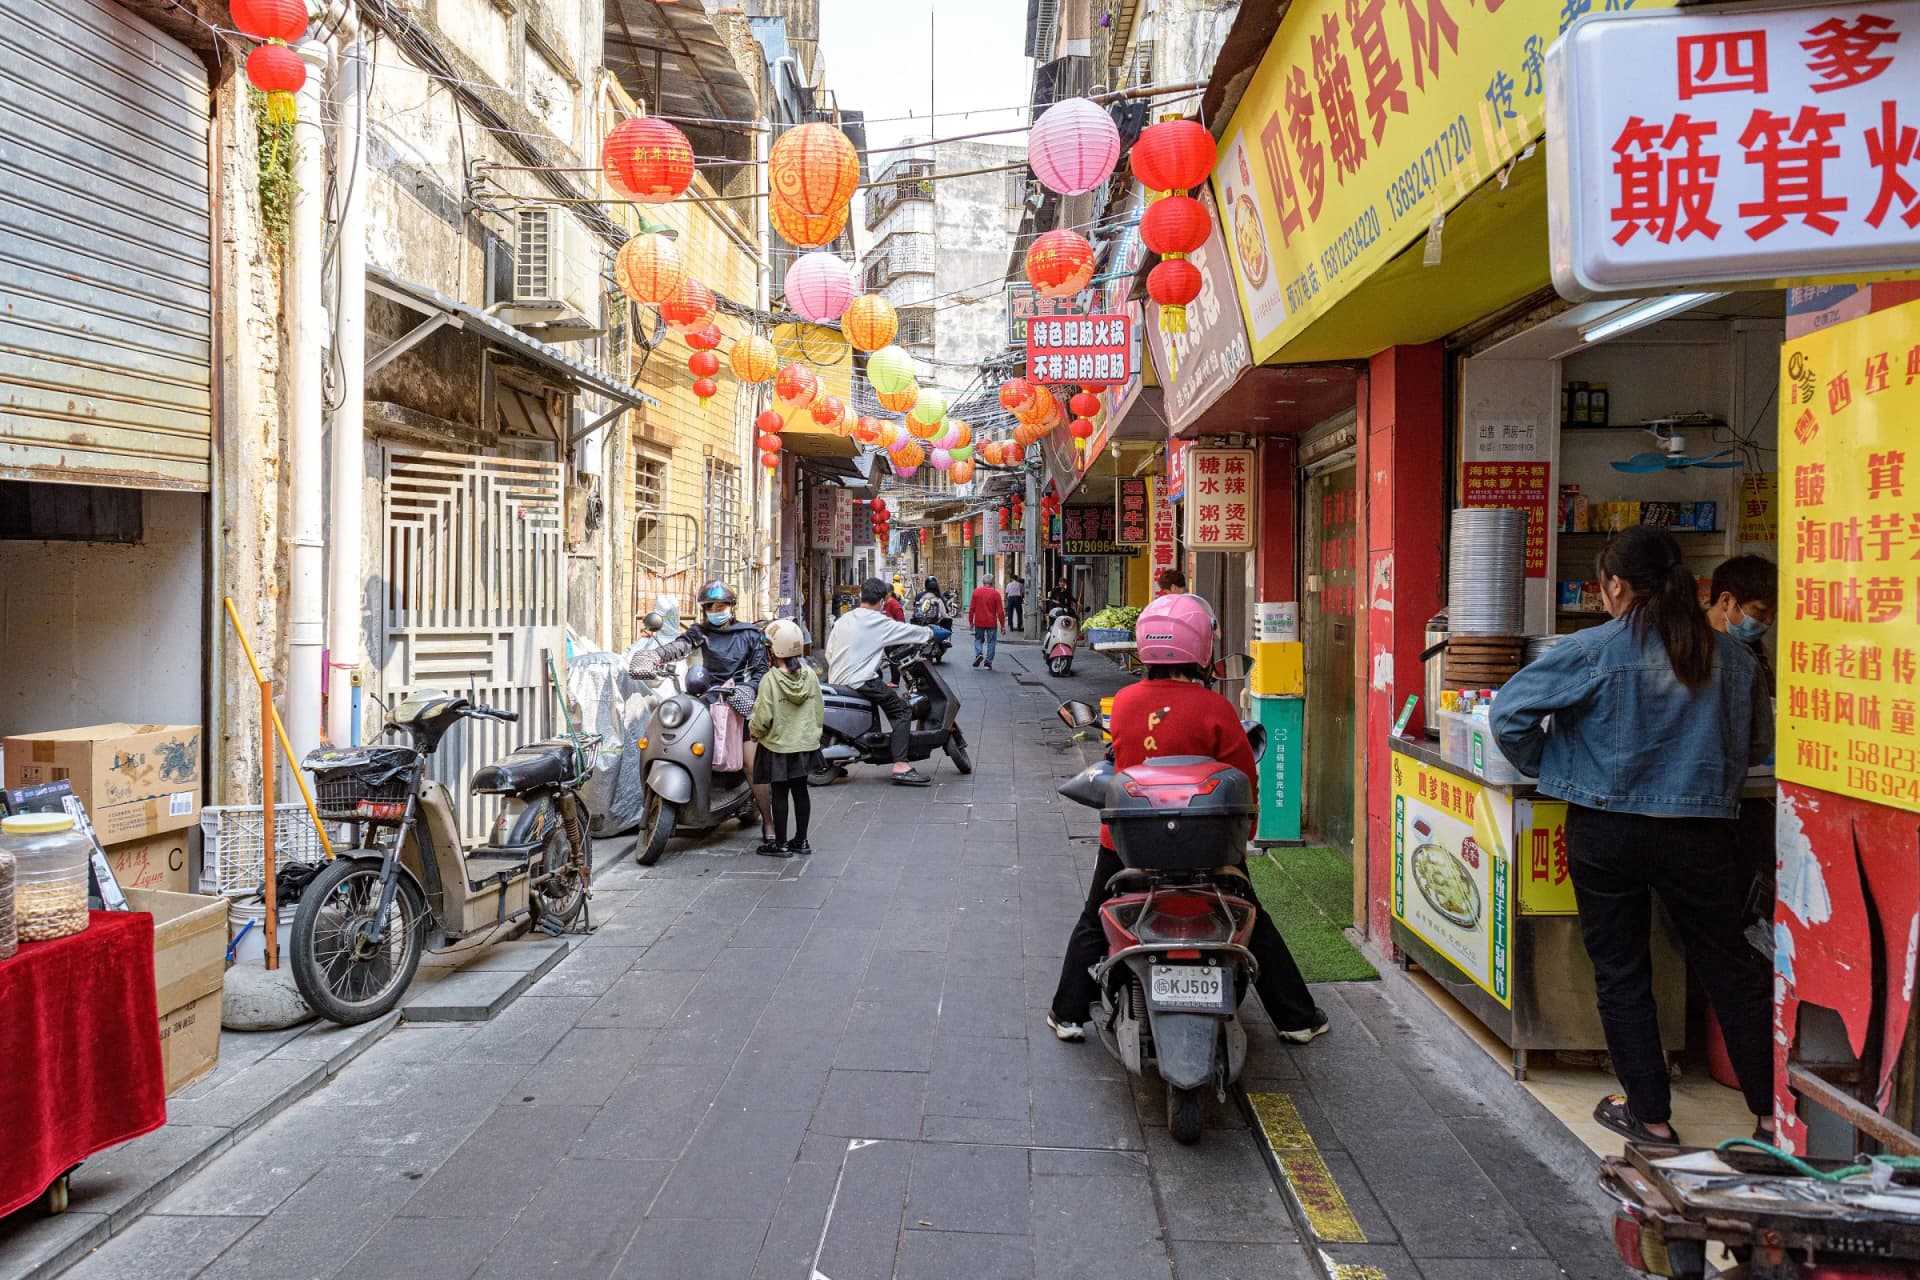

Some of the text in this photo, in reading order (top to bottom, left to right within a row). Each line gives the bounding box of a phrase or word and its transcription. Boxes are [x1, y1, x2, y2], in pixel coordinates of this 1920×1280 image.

[1676, 13, 1901, 101] 四爹
[1385, 114, 1473, 223] 13692471720
[1320, 204, 1382, 282] 15812334220
[1034, 320, 1125, 347] 特色肥肠火锅
[1034, 354, 1125, 380] 不带油的肥肠
[1790, 641, 1882, 681] 传承老档
[1789, 685, 1881, 730] 独特风味
[168, 847, 184, 872] C
